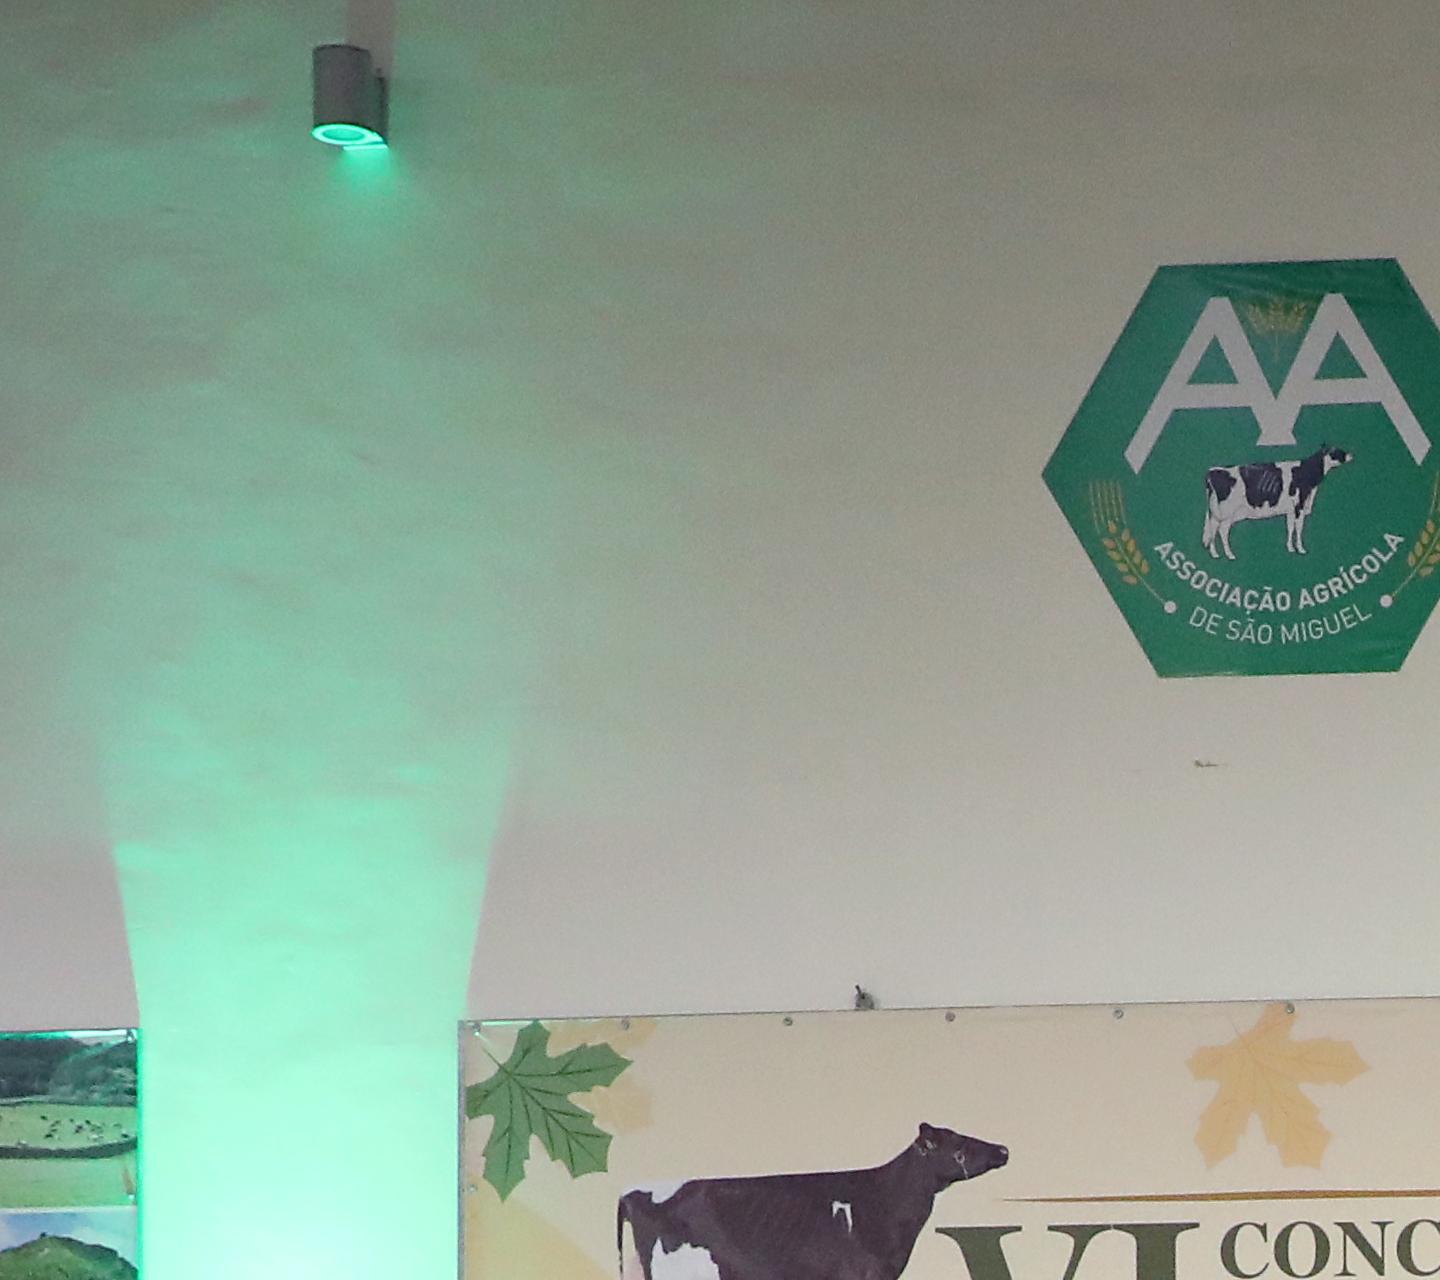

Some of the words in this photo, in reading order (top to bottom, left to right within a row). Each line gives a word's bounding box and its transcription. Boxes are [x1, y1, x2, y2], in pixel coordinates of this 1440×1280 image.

[1154, 540, 1291, 616] ASSOCIAÇÃO
[1298, 531, 1405, 611] AGRÍCOLA
[1188, 606, 1223, 636] DE
[1225, 612, 1273, 645] SÃO
[1280, 601, 1373, 645] MIGUEL
